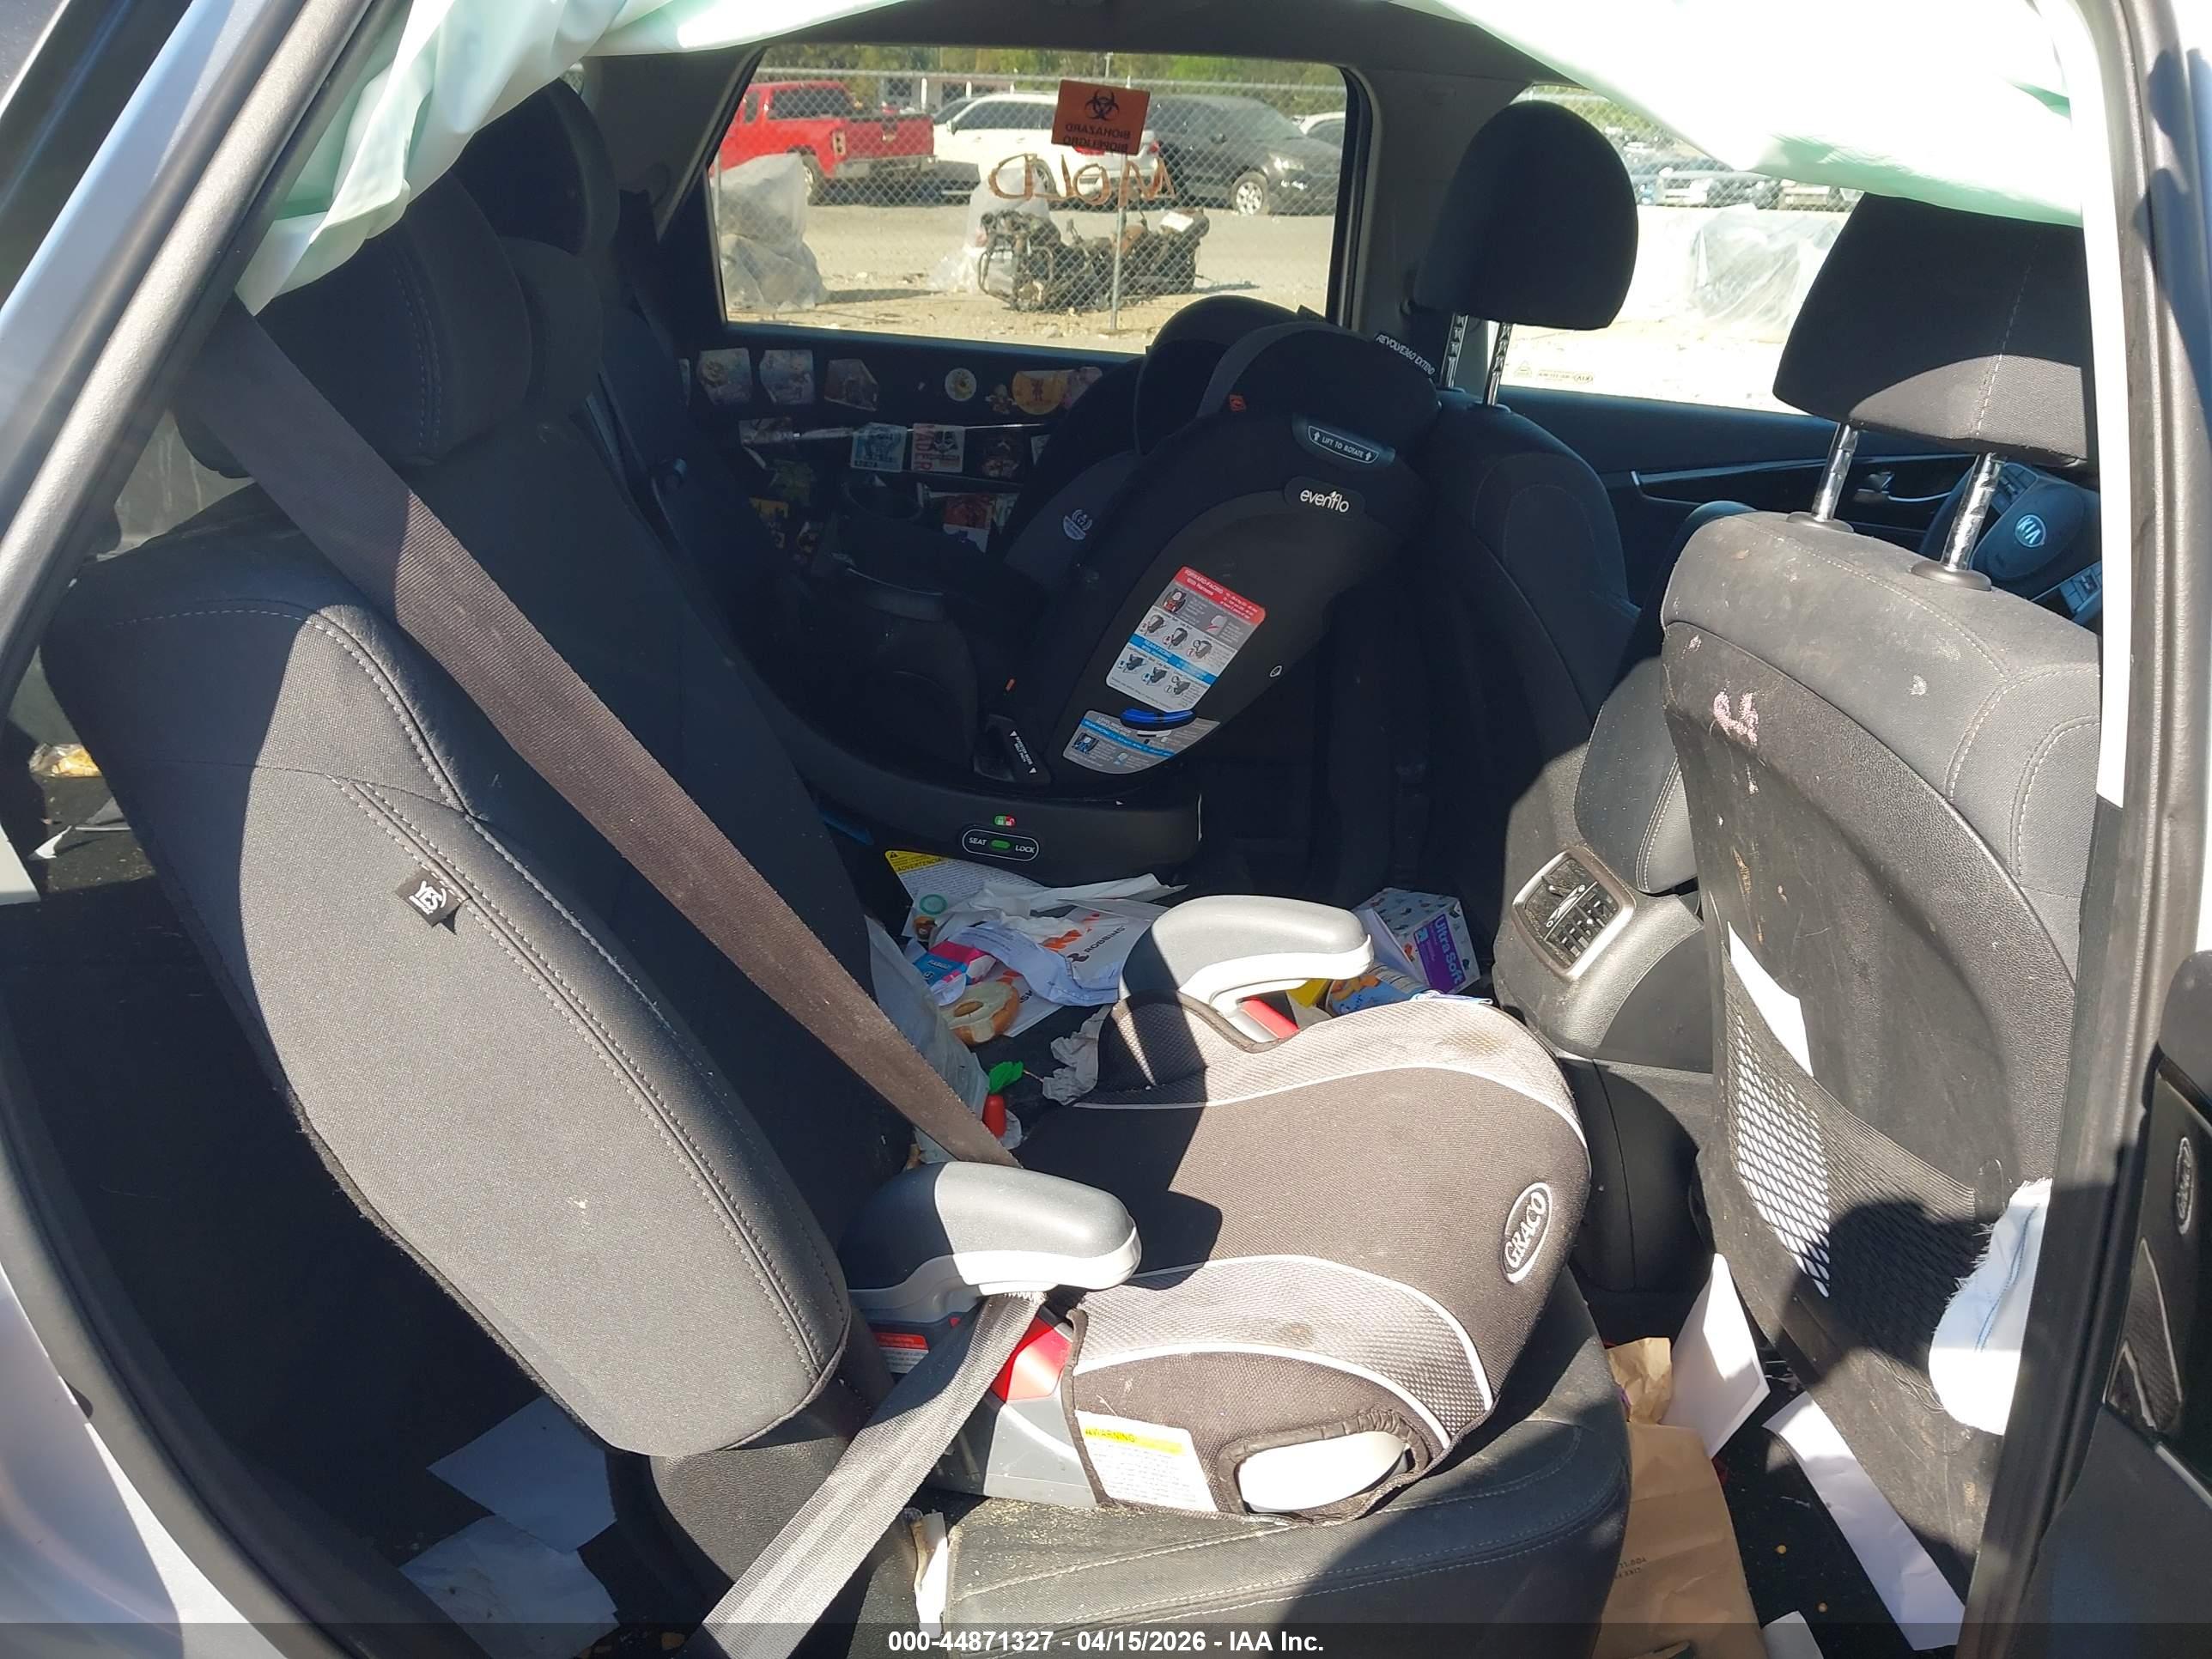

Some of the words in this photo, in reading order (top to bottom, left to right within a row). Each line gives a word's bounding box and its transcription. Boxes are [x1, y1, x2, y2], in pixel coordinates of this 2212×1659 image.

[1322, 436, 1334, 446] LIFT
[1344, 445, 1364, 459] ROTATE
[1299, 489, 1350, 514] evenflo
[2017, 518, 2041, 544] KIA
[969, 837, 988, 846] SEAT
[1015, 845, 1036, 854] LOCK
[414, 880, 443, 911] YES
[1434, 916, 1451, 954] Ultra
[1446, 953, 1464, 984] Soft
[1504, 1191, 1547, 1268] GRACO
